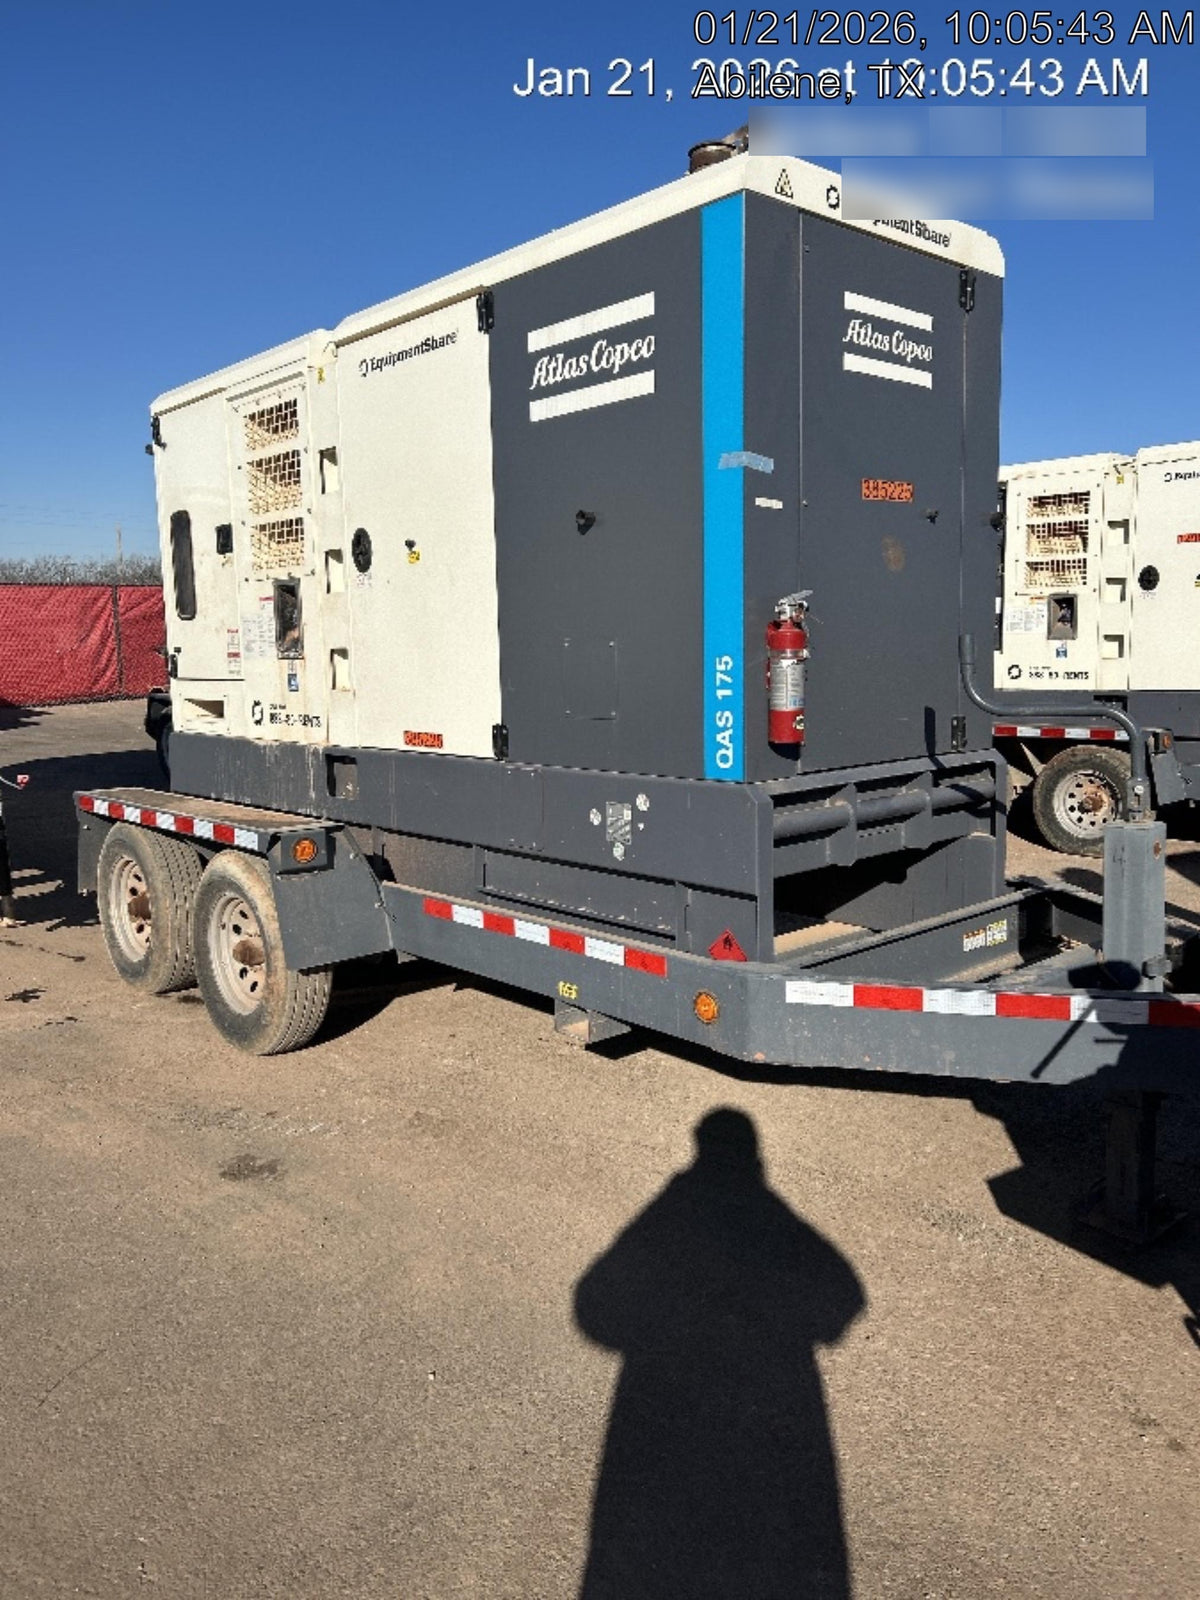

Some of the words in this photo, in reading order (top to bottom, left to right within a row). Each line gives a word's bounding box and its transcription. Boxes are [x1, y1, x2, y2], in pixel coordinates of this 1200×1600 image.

[370, 330, 458, 373] EquipmentShare
[529, 353, 589, 391] Atlas
[590, 335, 655, 374] Copco
[842, 319, 890, 352] Atlas
[892, 330, 932, 363] Copco
[715, 655, 733, 700] 175
[715, 710, 733, 769] QAS
